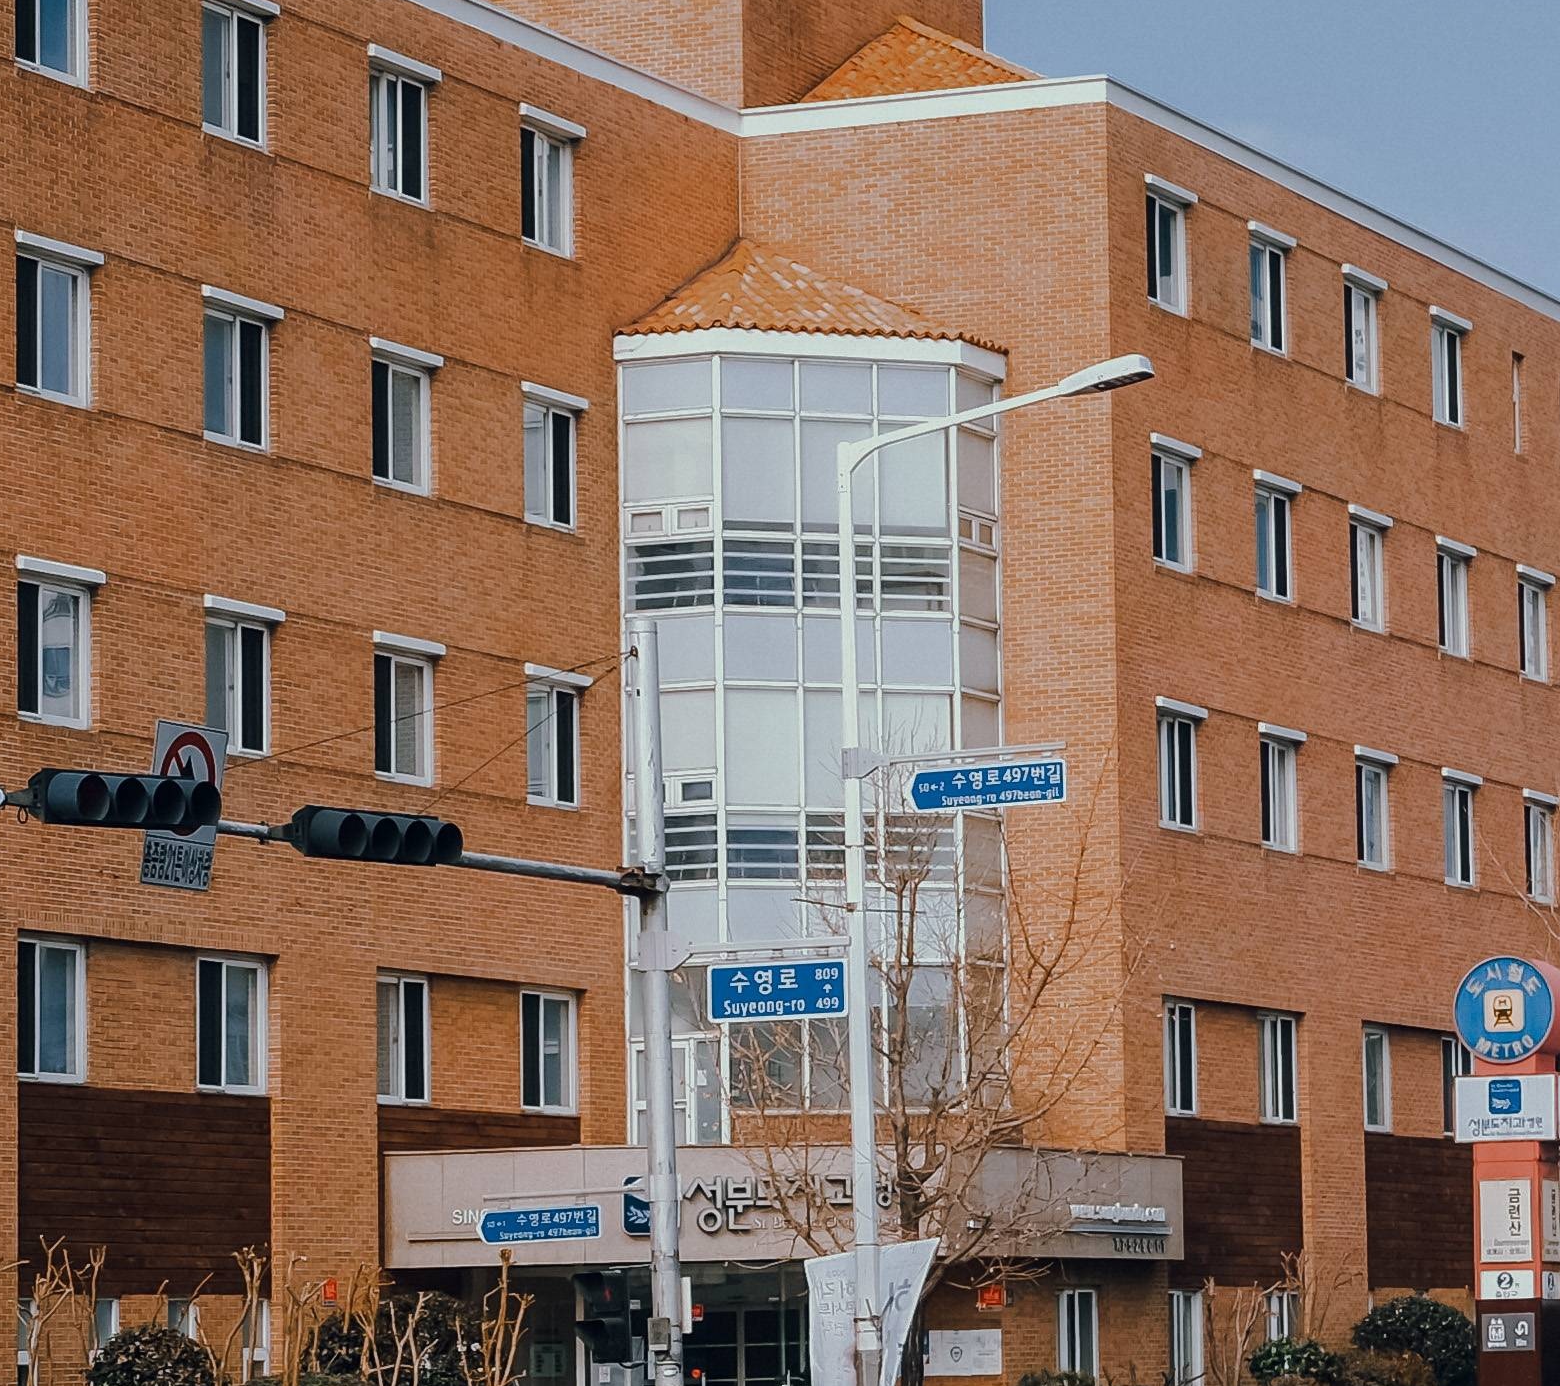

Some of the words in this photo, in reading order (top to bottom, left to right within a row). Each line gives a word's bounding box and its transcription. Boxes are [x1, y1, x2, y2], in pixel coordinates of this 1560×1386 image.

[952, 764, 1061, 790] 수영로497번길
[729, 967, 799, 995] 수영로
[814, 967, 839, 981] 809
[723, 998, 805, 1017] Suyeong-ro
[1475, 1033, 1535, 1058] METRO
[1500, 1272, 1512, 1289] 2
